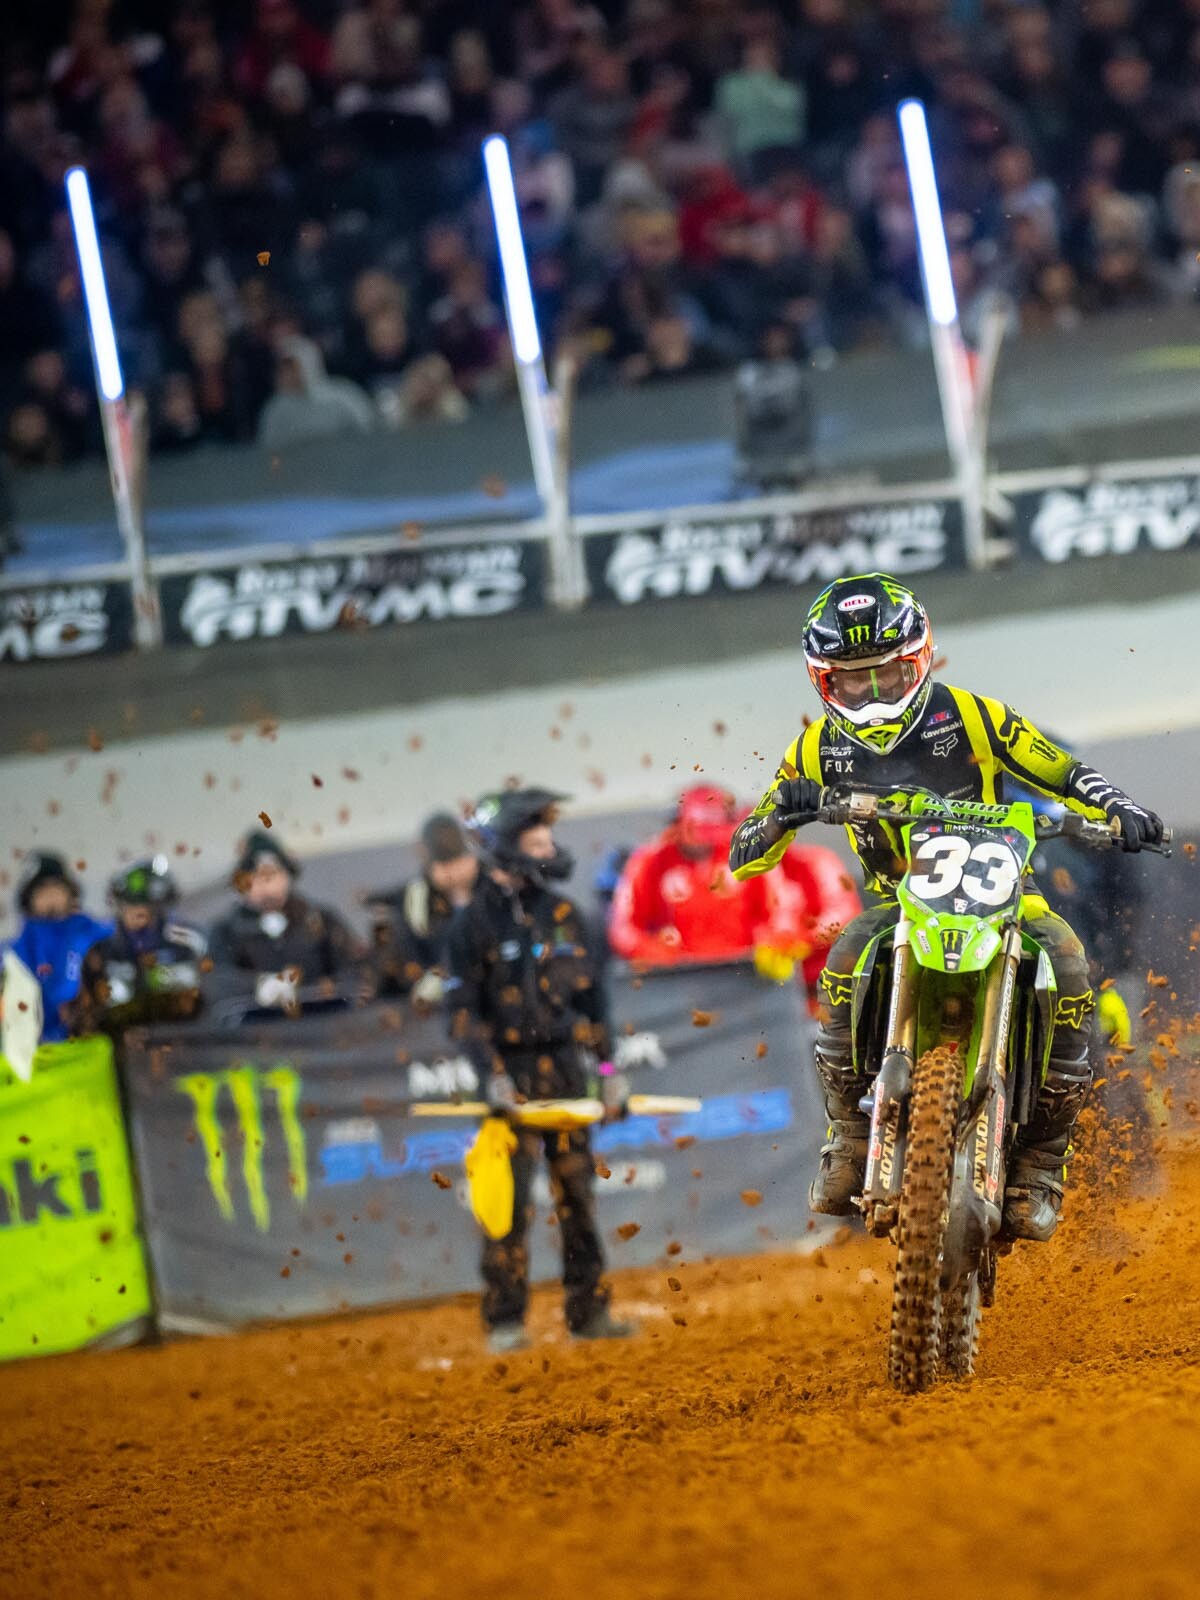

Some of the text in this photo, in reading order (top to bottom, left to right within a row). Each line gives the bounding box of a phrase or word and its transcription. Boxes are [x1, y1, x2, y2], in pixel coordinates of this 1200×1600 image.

[844, 597, 870, 608] BELL
[825, 759, 854, 773] FOX
[909, 835, 1023, 906] 33
[879, 1097, 901, 1190] NLOP
[0, 1149, 104, 1229] ki
